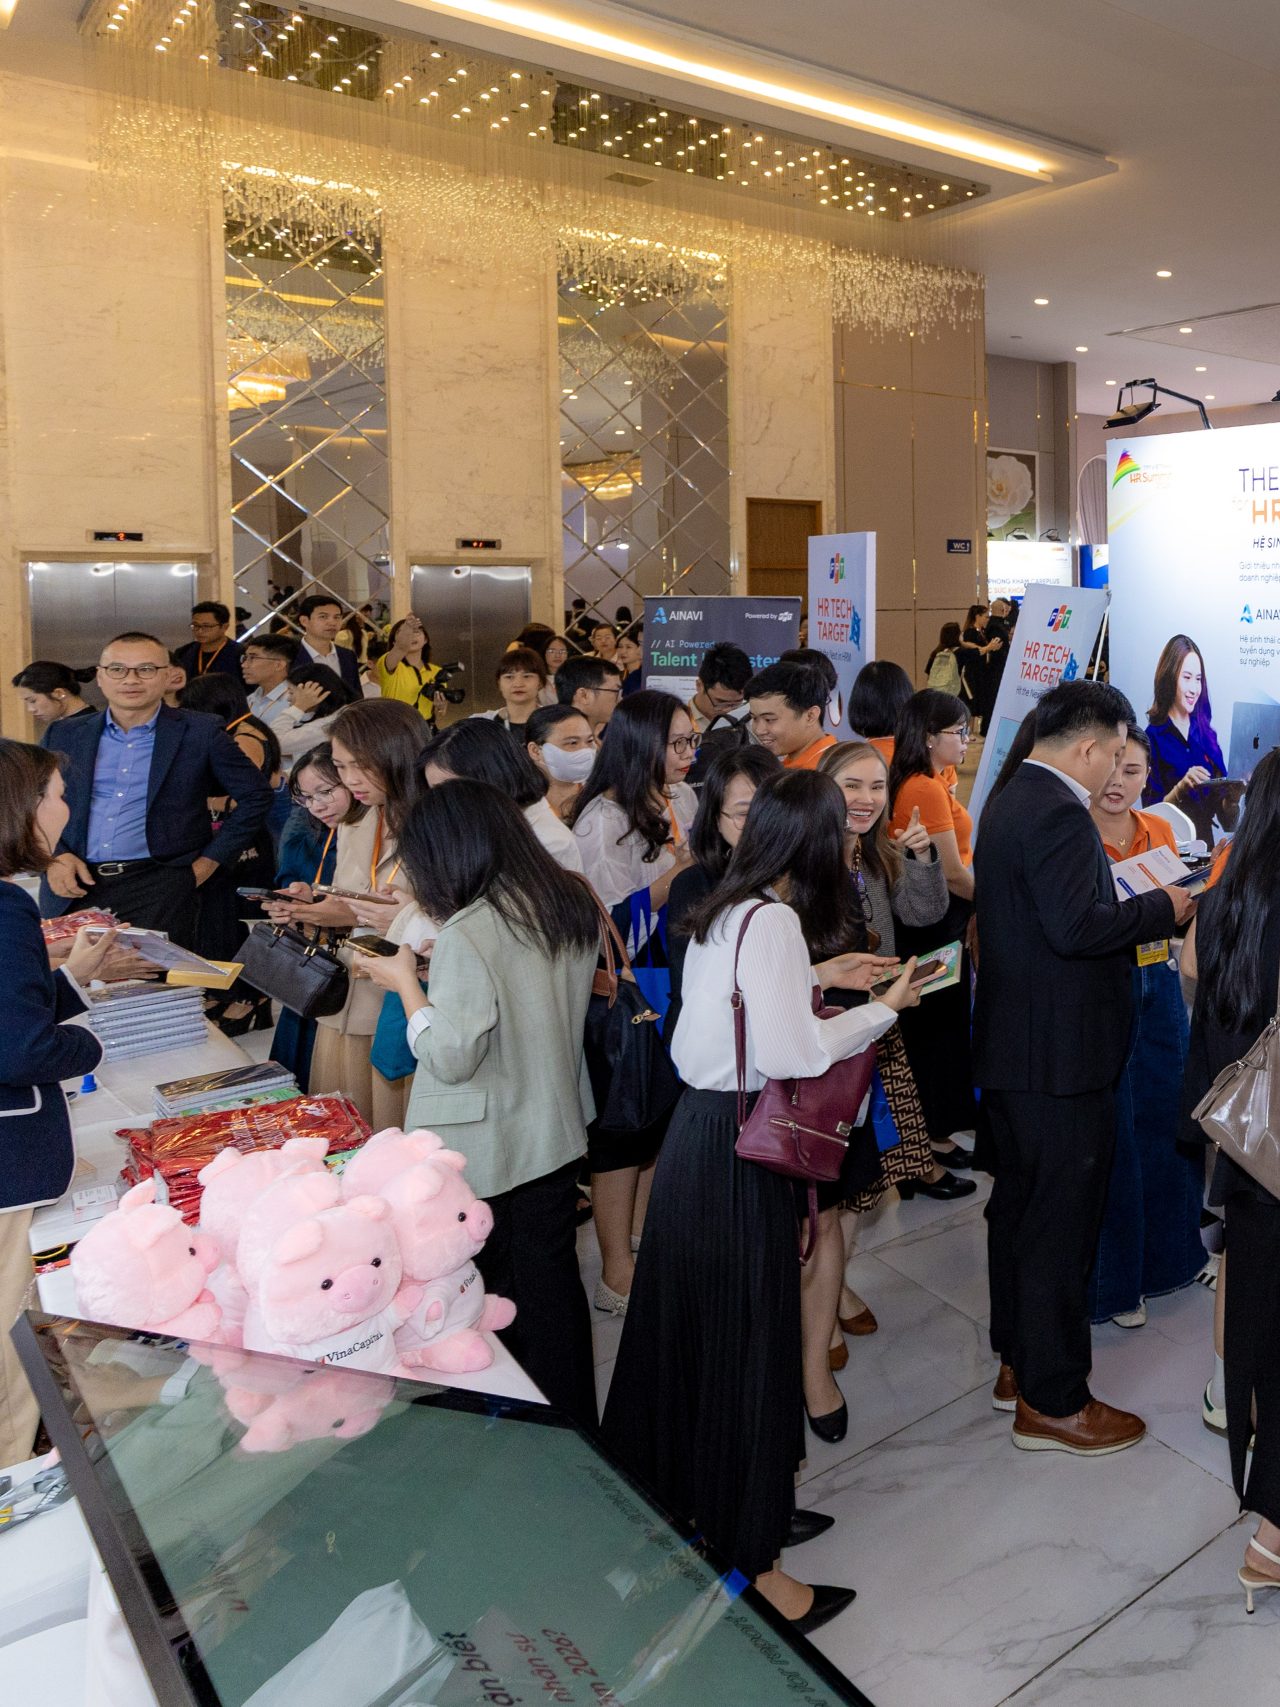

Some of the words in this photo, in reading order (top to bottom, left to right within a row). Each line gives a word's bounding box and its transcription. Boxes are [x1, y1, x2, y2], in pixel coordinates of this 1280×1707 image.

[1239, 466, 1279, 492] THE
[1253, 534, 1266, 551] HỆ
[669, 610, 703, 622] AINAVI
[817, 597, 830, 617] HR
[831, 598, 852, 620] TECH
[665, 640, 675, 648] AI
[817, 621, 850, 644] TARGET
[651, 651, 698, 667] Talent
[1023, 640, 1040, 660] HR
[1041, 643, 1072, 667] TECH
[1020, 662, 1063, 687] TARGET
[326, 1331, 384, 1363] VinaCapital
